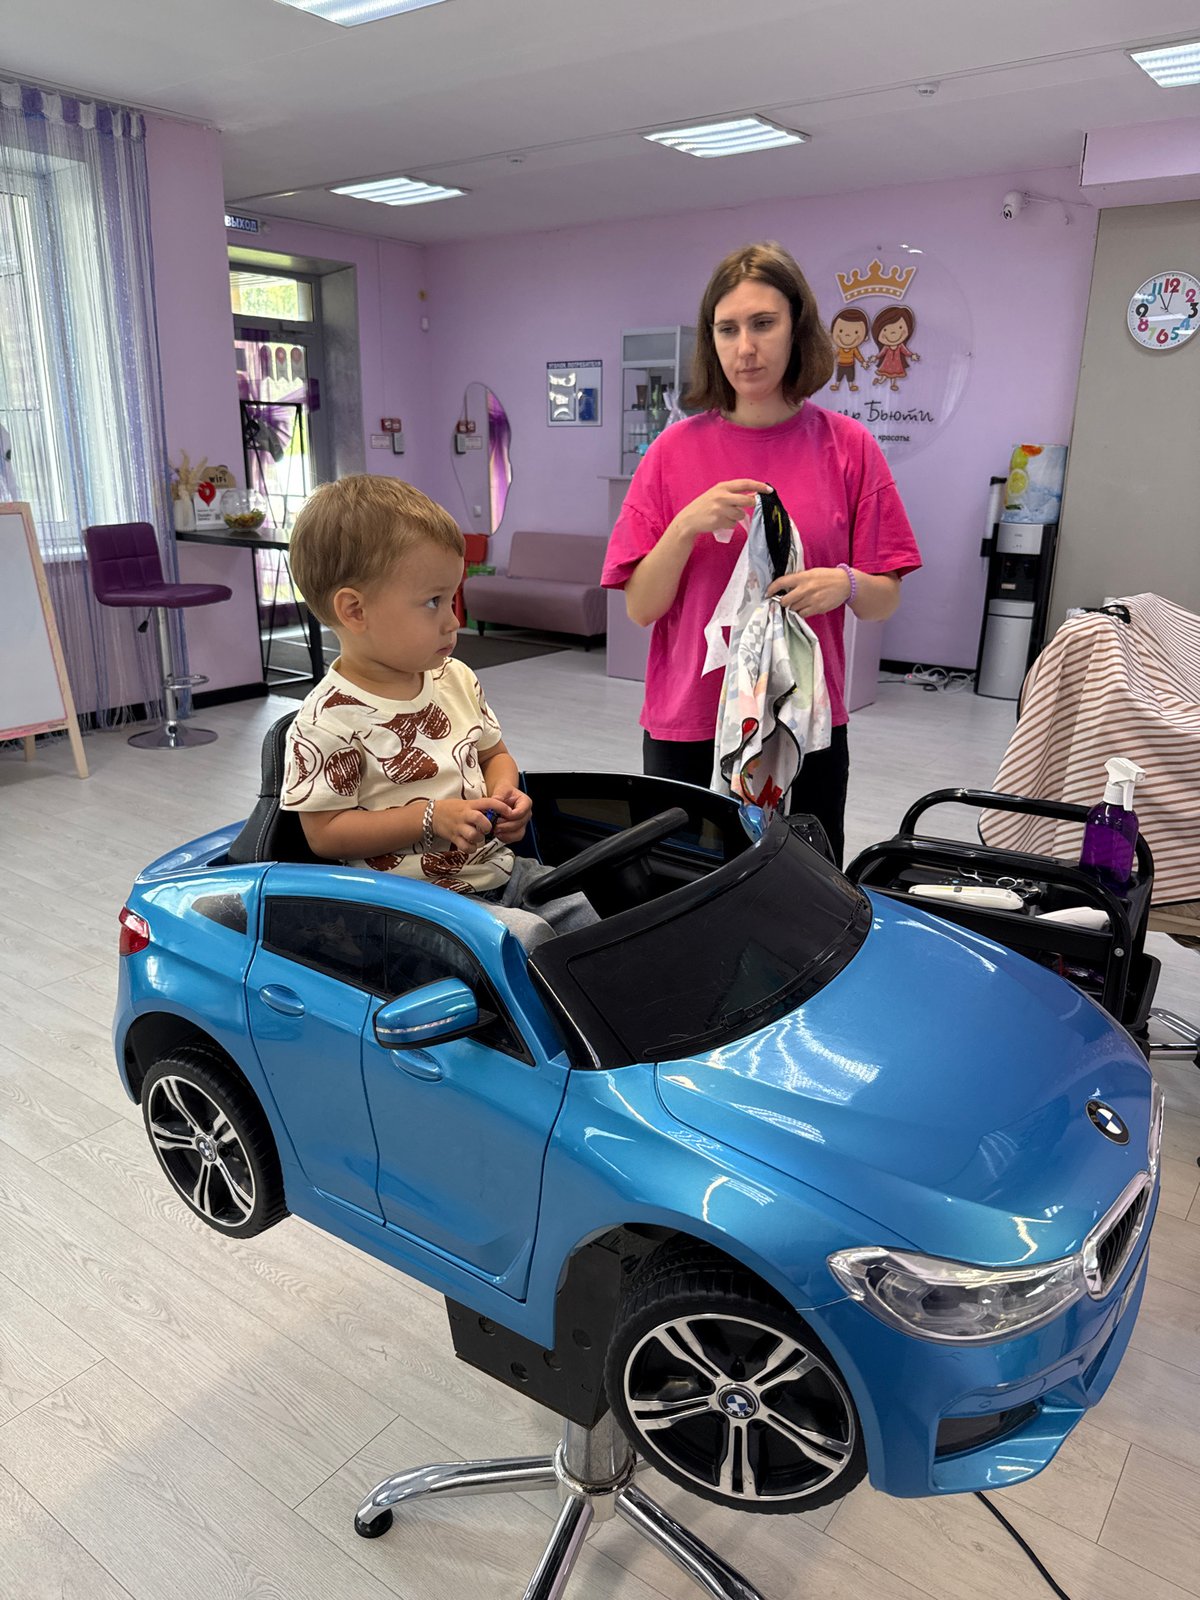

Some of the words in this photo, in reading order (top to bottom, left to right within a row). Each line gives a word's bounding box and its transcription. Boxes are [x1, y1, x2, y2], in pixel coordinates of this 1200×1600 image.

[224, 214, 258, 232] ВЫХОД
[1152, 283, 1163, 294] 11
[1164, 278, 1181, 293] 12
[1185, 289, 1196, 303] 2
[1135, 303, 1149, 319] 9
[1188, 302, 1199, 318] 3
[1138, 317, 1149, 332] 8
[1180, 317, 1191, 330] 4
[1147, 327, 1157, 340] 7
[1156, 329, 1169, 344] 6
[1170, 327, 1180, 340] 5
[864, 400, 934, 422] Бьюти
[878, 434, 910, 443] красоты
